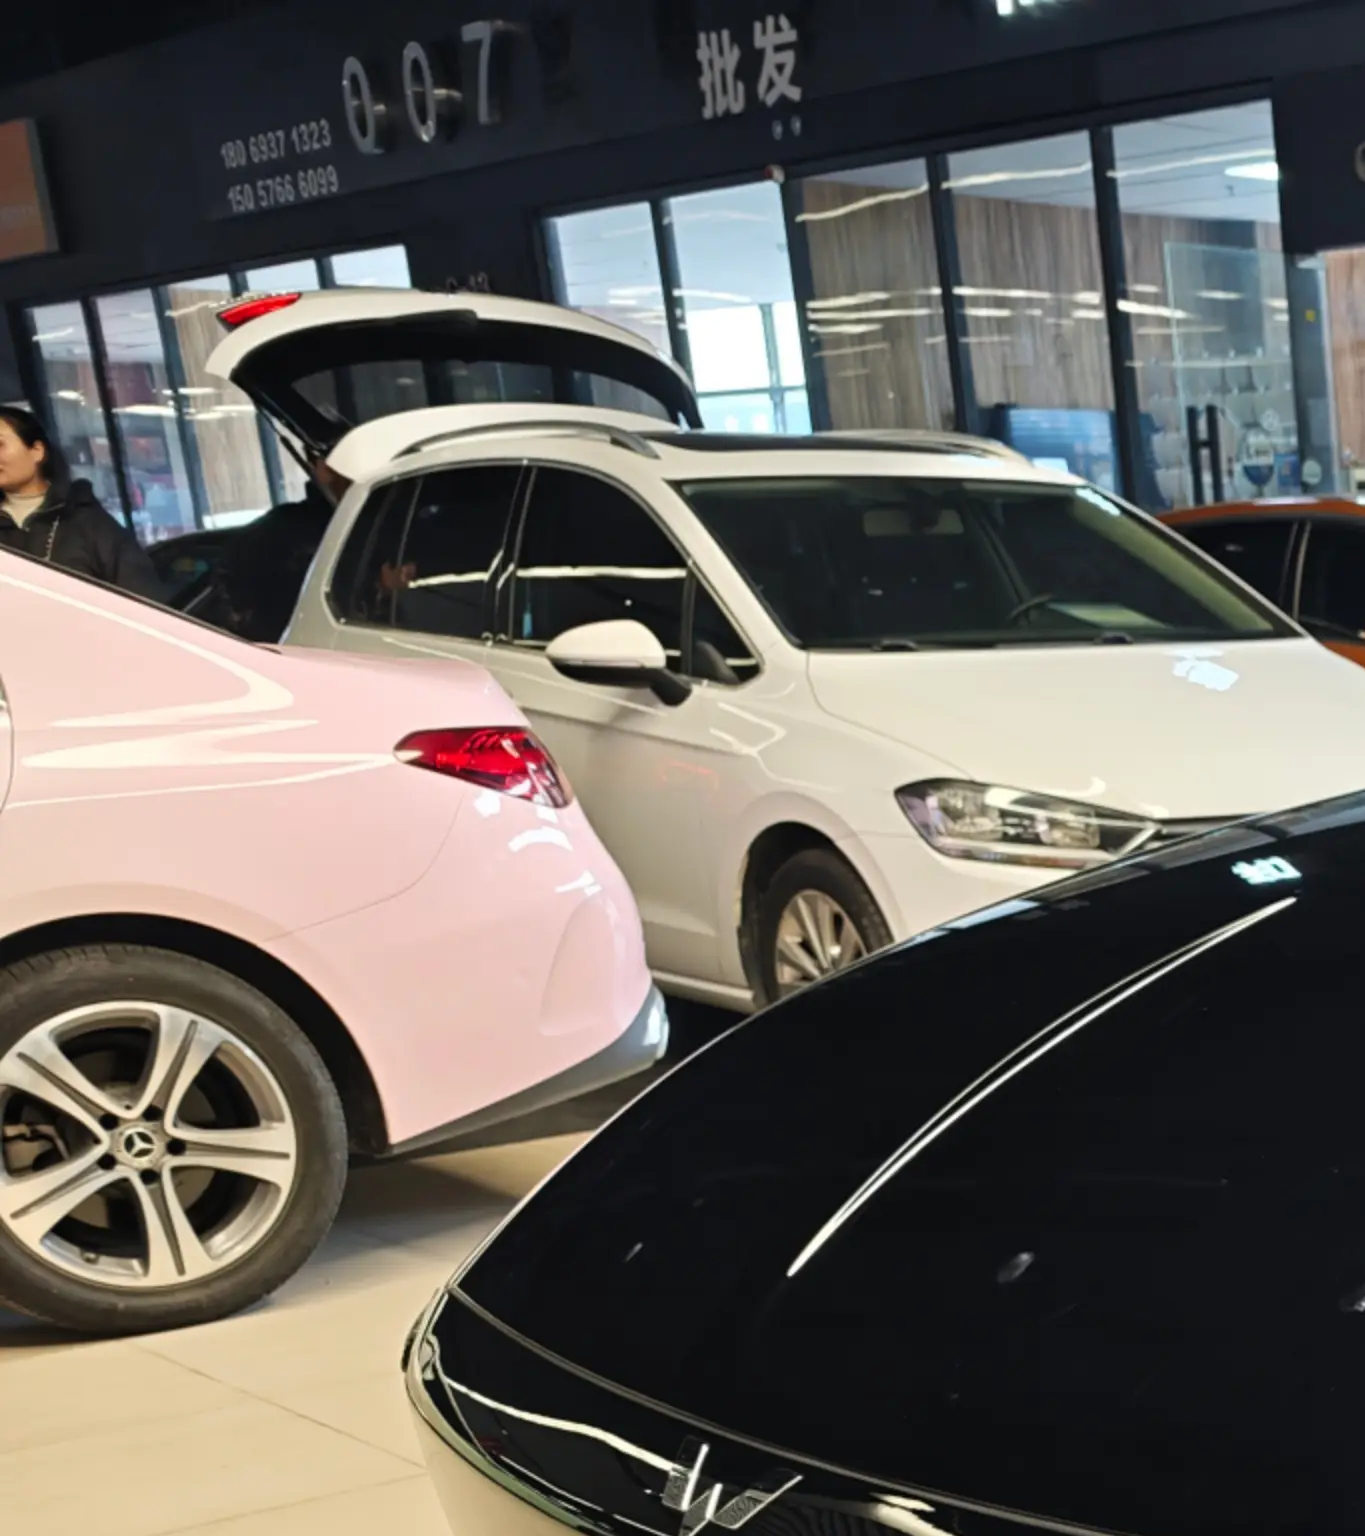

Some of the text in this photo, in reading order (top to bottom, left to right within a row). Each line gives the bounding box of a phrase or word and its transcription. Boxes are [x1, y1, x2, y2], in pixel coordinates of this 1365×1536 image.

[696, 13, 802, 119] 批发
[249, 129, 285, 163] 6937
[291, 117, 332, 154] 1323
[256, 174, 295, 207] 5766
[298, 164, 339, 198] 6099
